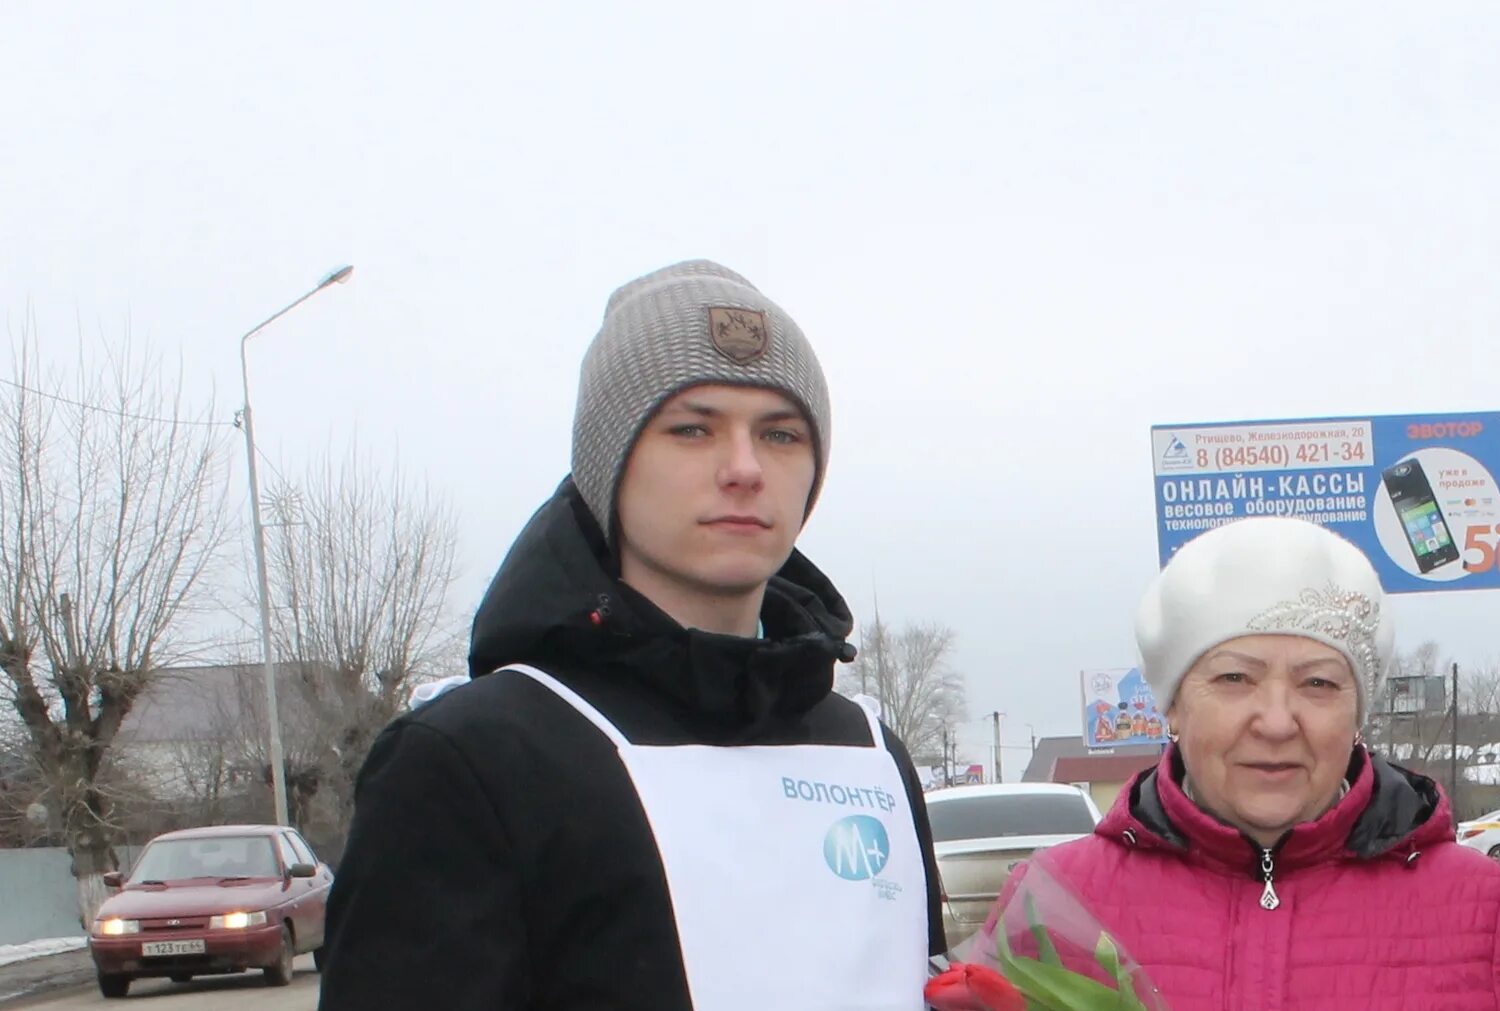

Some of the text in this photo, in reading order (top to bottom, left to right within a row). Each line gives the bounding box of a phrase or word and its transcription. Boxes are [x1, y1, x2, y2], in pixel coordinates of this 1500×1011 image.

[1195, 427, 1364, 444] Ртищево, Железнодорожная, 20
[1407, 421, 1483, 439] ЭВОТОР
[1197, 441, 1365, 471] 8 (84540) 421-34
[1163, 472, 1364, 502] ОНЛАЙН-КАССЫ
[1164, 495, 1366, 518] весовое оборудование
[782, 777, 896, 813] ВОЛОНТЁР
[155, 943, 173, 953] 123
